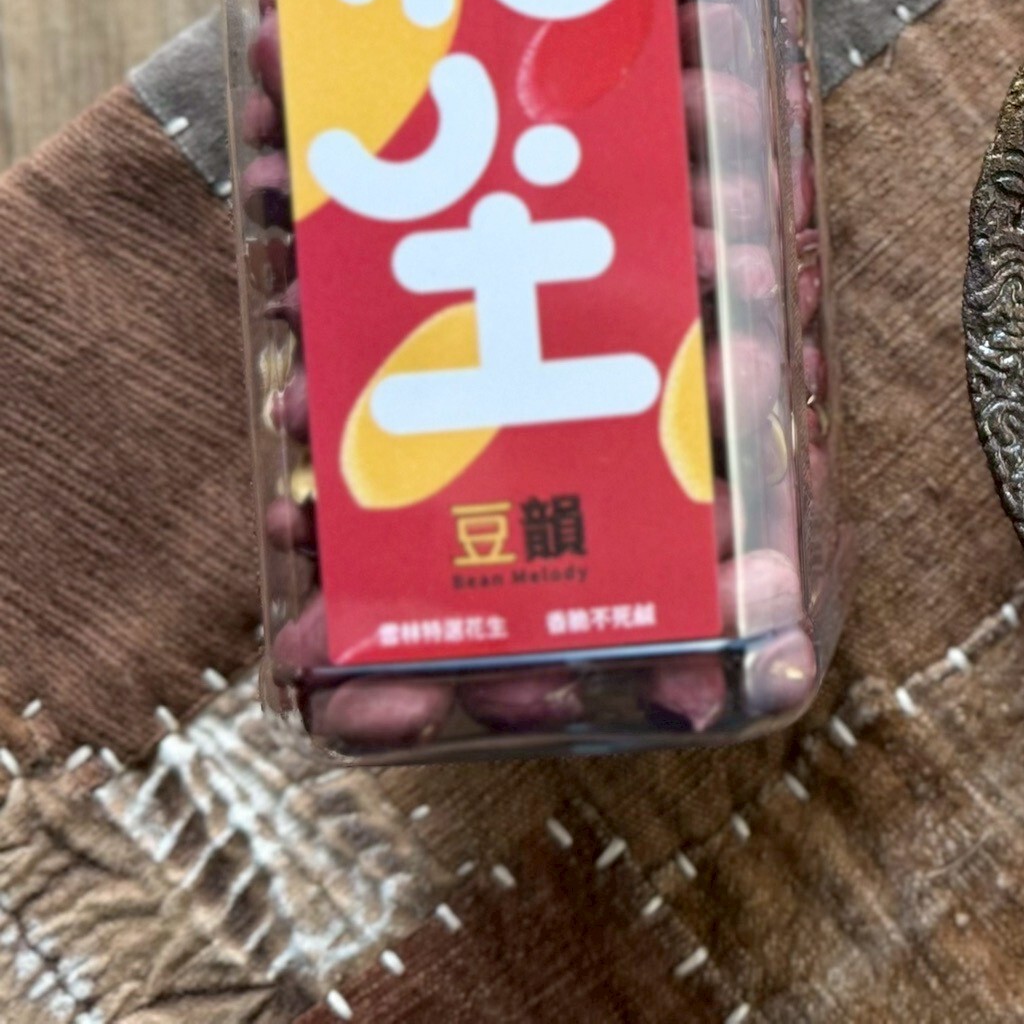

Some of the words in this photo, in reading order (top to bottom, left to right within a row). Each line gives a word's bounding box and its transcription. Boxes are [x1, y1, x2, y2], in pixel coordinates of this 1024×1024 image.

[451, 494, 587, 566] 豆韻
[453, 573, 504, 589] Bean
[511, 565, 588, 585] Melody
